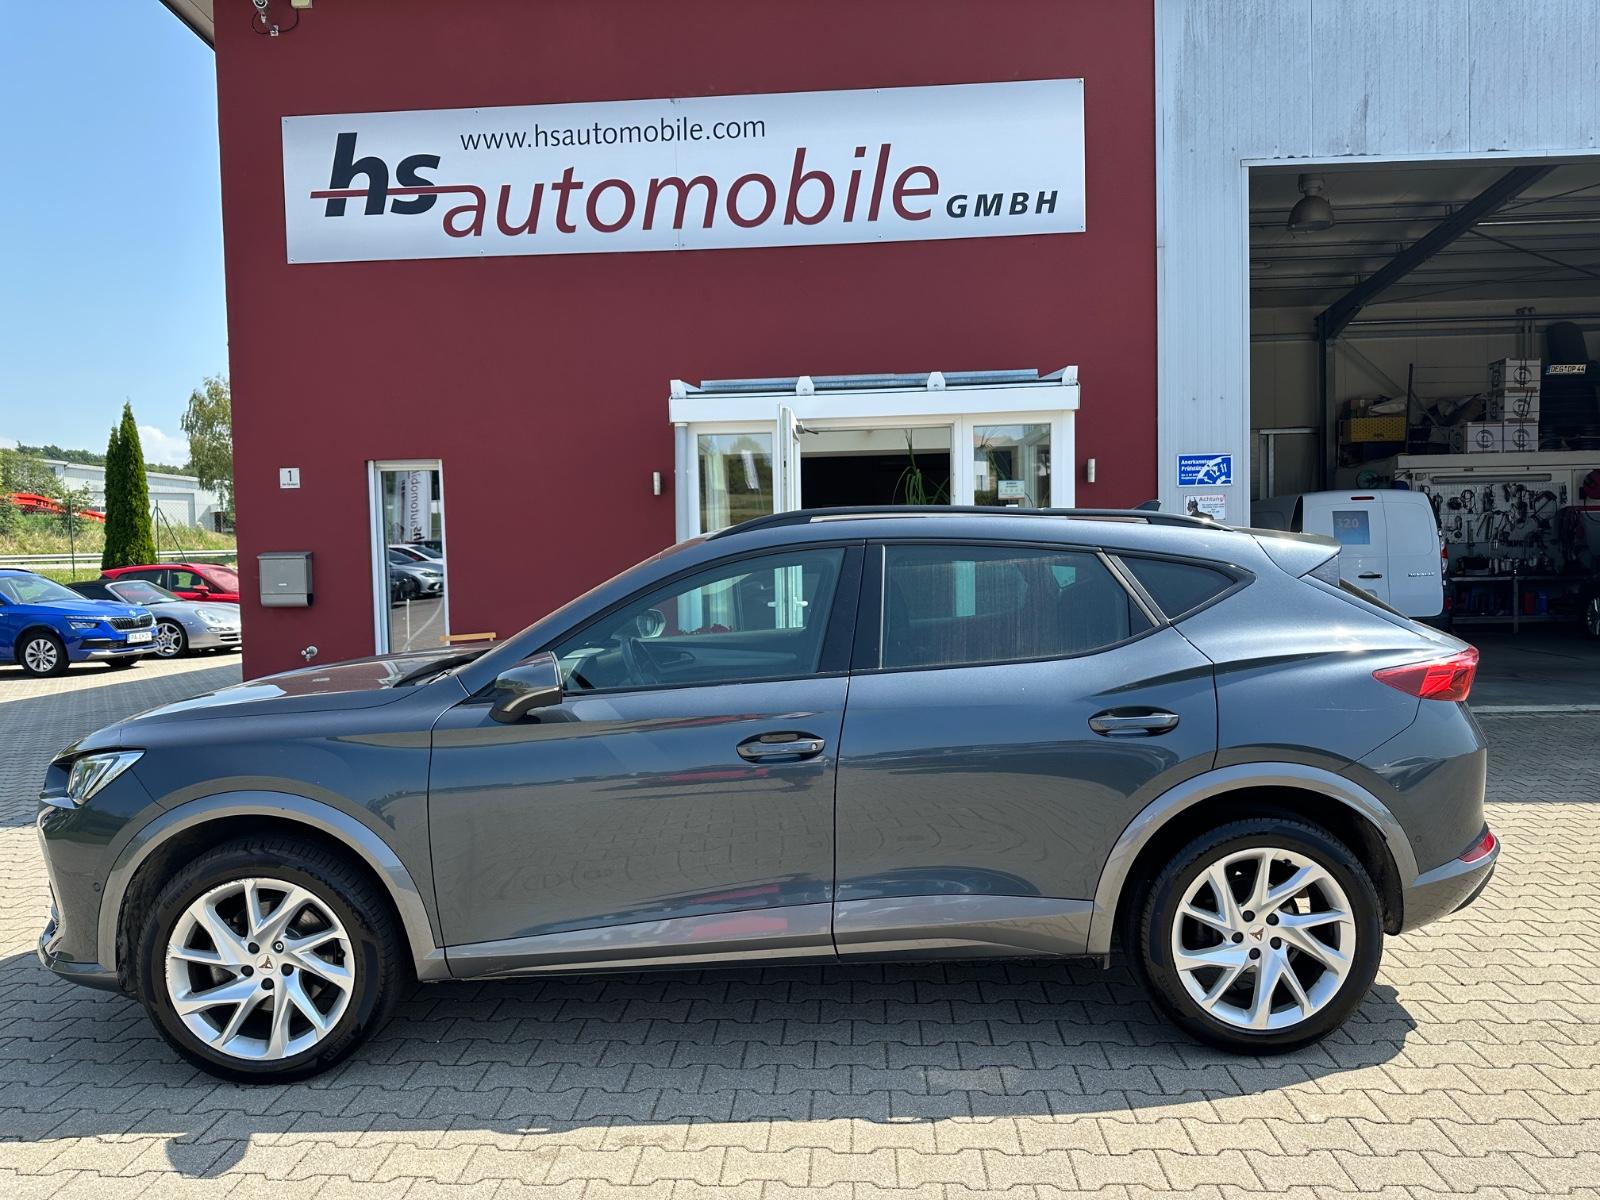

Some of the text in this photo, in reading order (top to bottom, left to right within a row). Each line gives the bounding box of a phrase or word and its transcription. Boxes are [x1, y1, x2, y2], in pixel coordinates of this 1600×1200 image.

[461, 119, 765, 151] www.hsautomobile.com
[443, 144, 937, 238] automobile
[947, 190, 1058, 218] GMBH
[287, 470, 292, 482] 1
